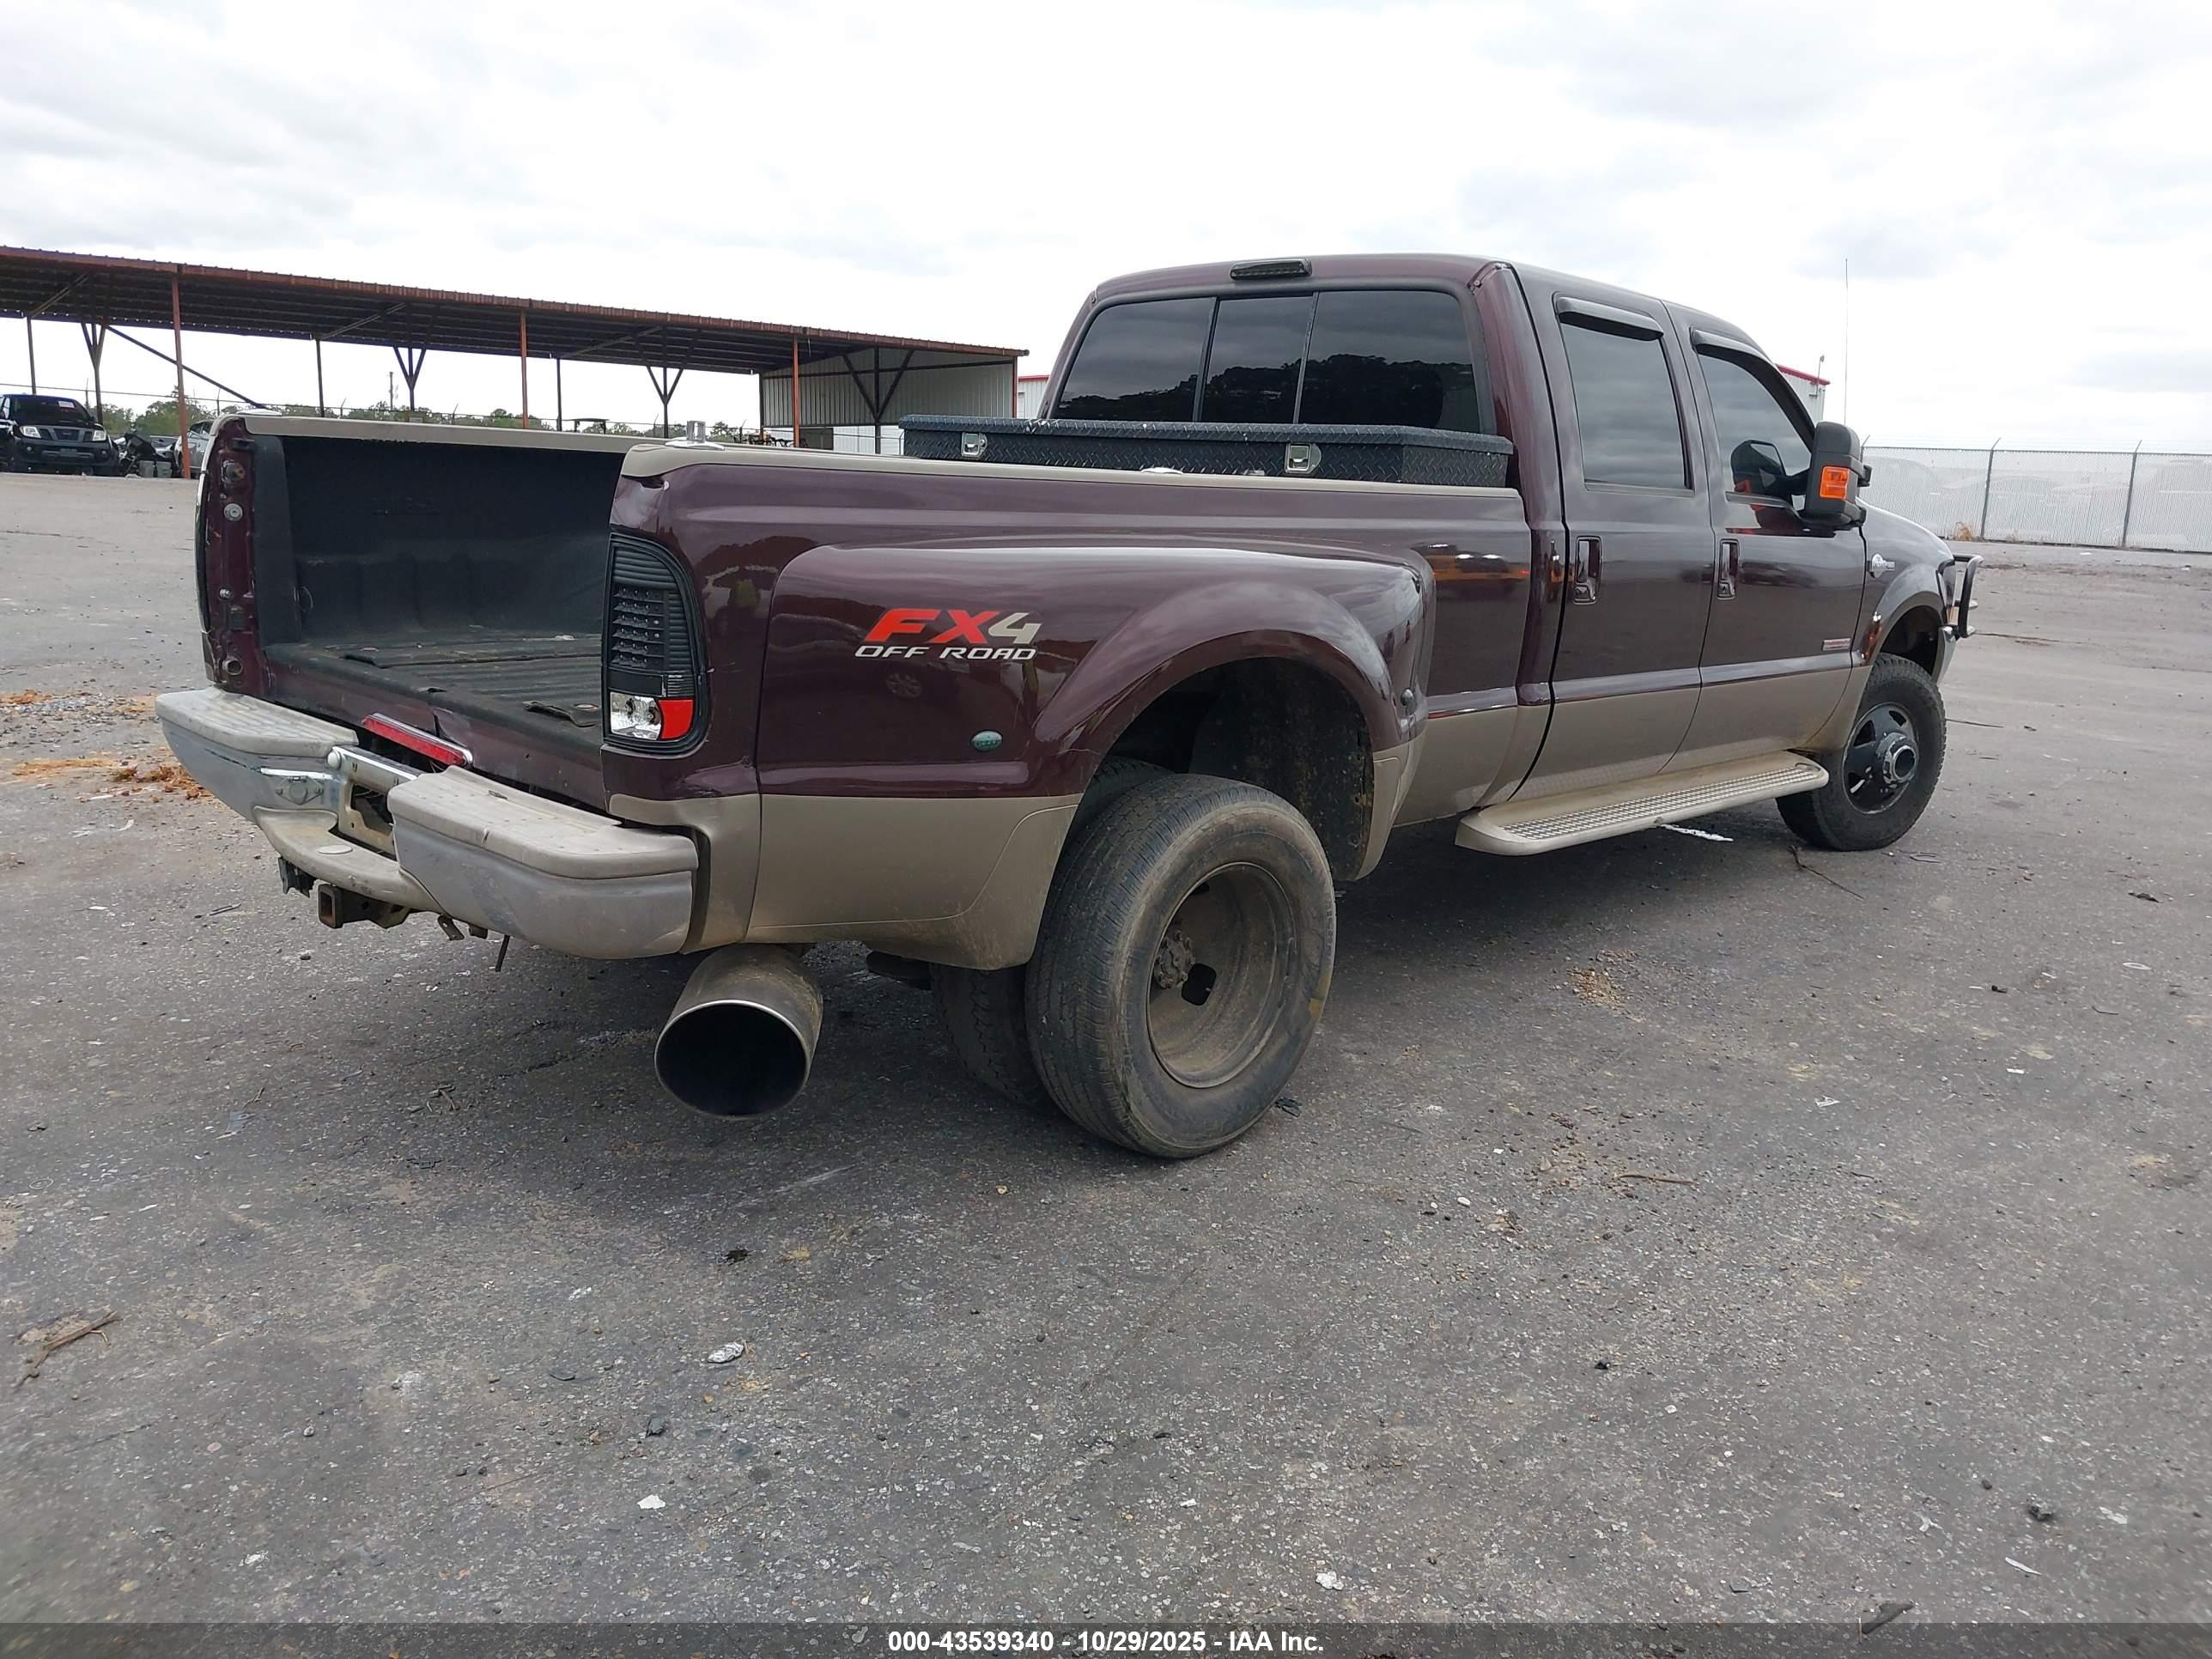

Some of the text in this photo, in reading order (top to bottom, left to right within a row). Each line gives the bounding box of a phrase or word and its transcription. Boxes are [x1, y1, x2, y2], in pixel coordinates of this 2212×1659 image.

[864, 607, 1042, 644] FX4
[854, 645, 1038, 660] OFF ROAD
